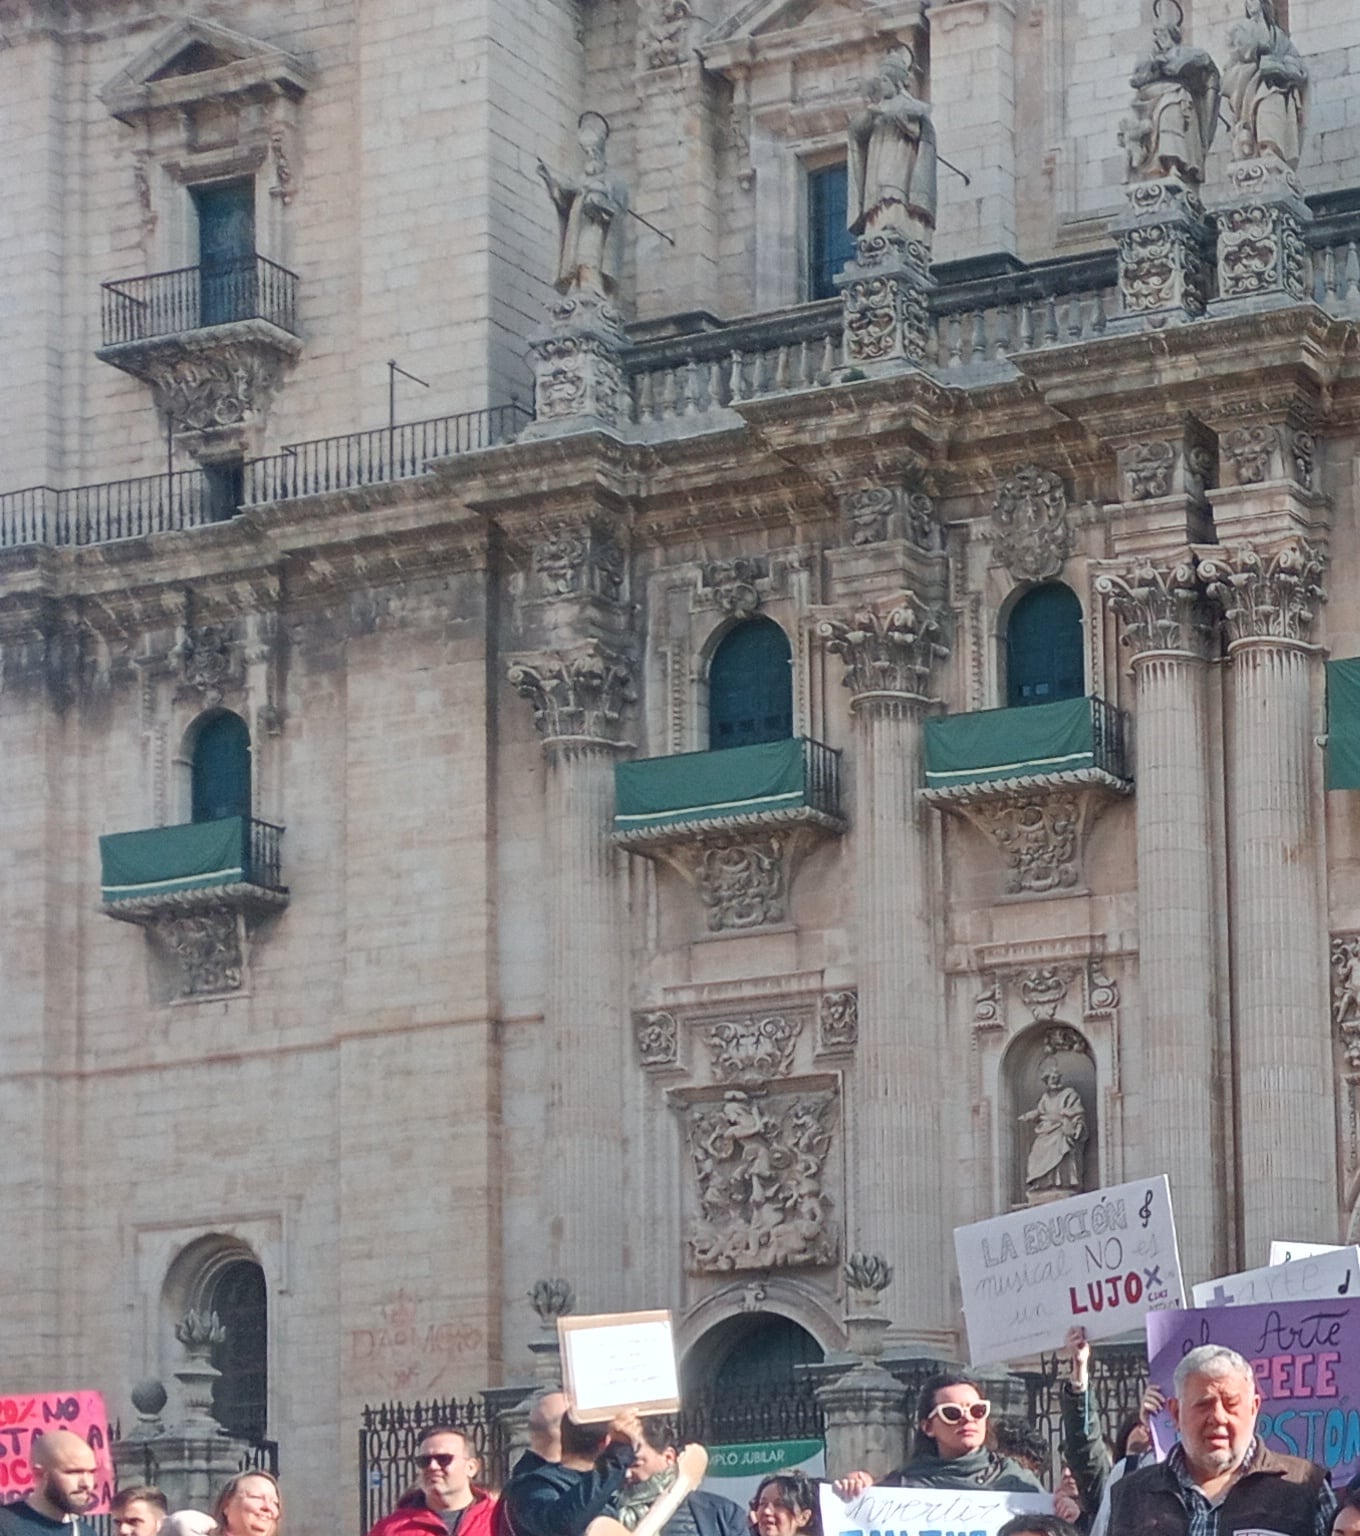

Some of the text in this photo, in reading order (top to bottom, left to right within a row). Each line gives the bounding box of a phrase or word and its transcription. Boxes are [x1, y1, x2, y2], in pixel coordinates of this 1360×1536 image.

[975, 1250, 1071, 1297] musical
[1085, 1236, 1124, 1273] NO
[981, 1232, 1019, 1268] LA
[1069, 1271, 1144, 1316] LUJO
[1257, 1309, 1350, 1352] Arte
[42, 1397, 80, 1423] NO
